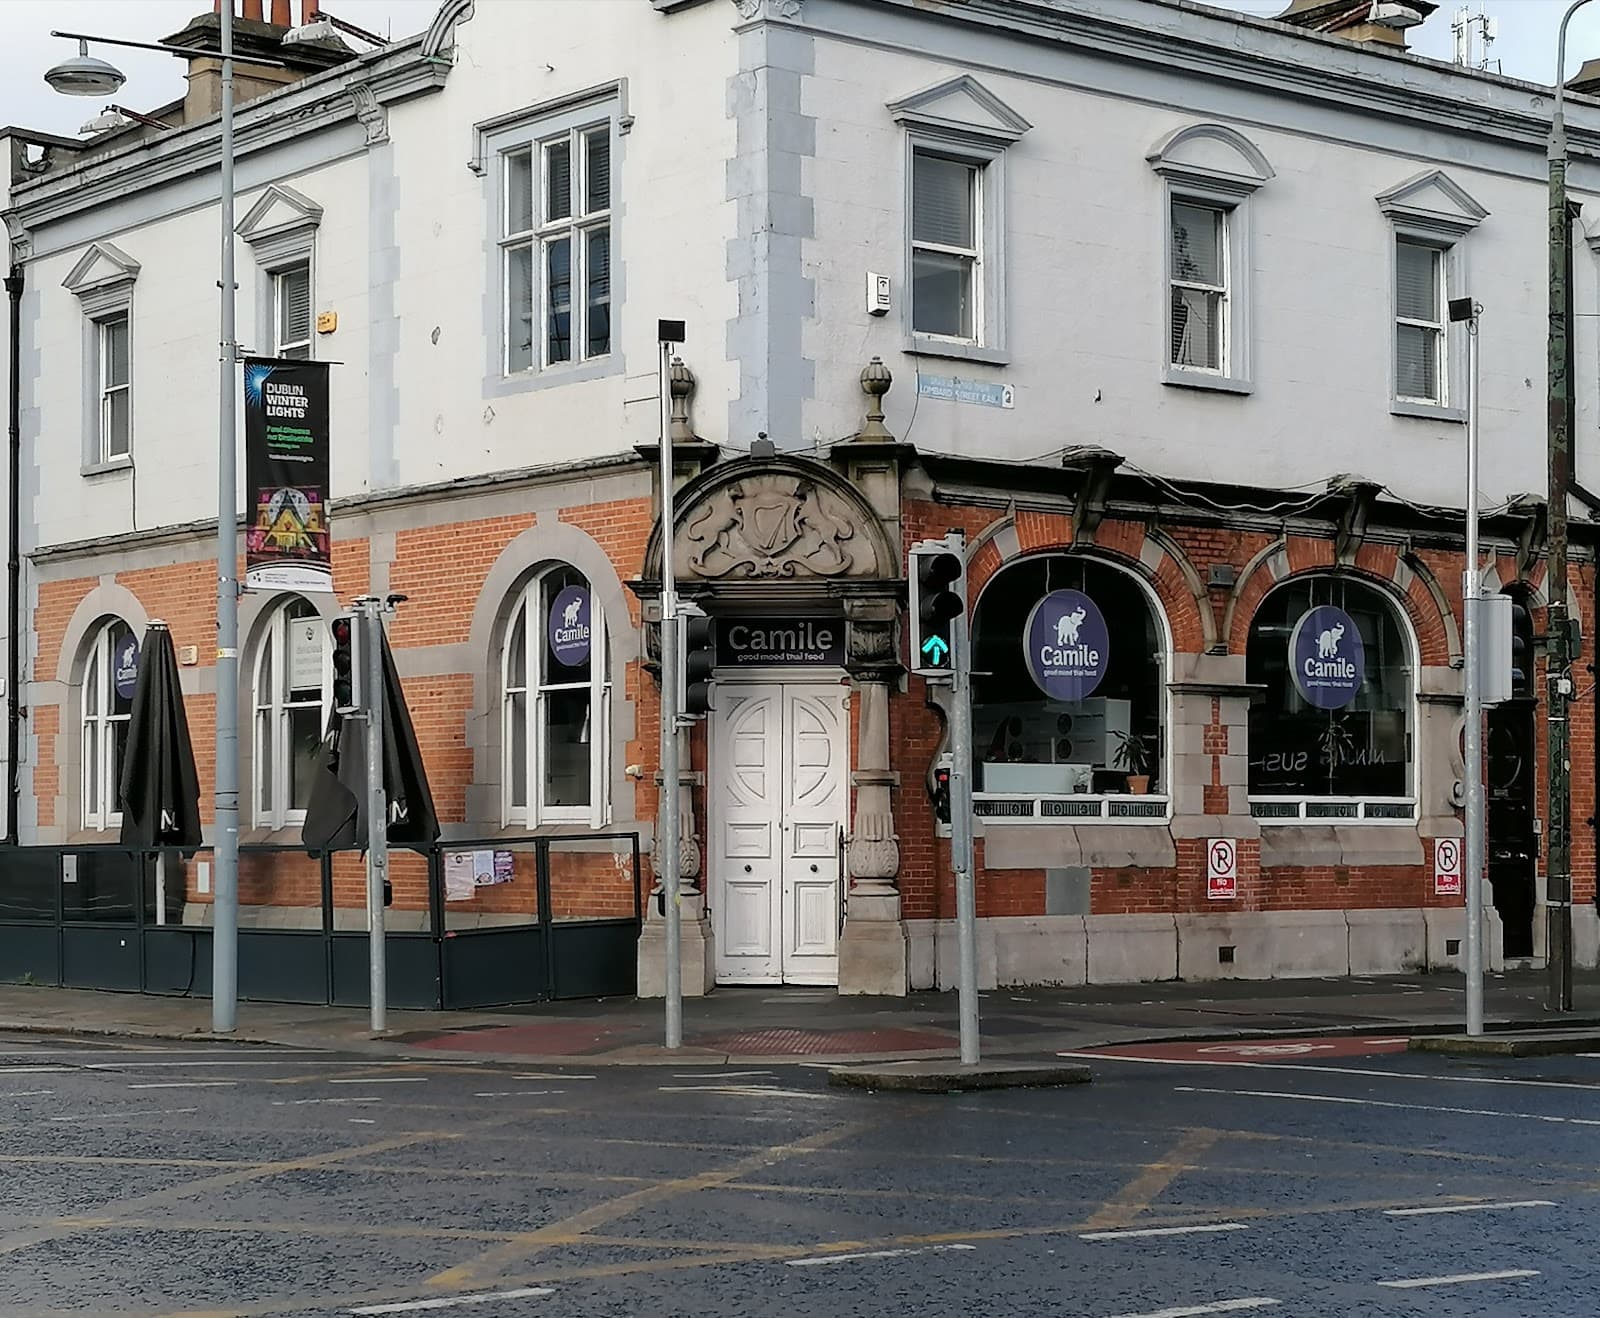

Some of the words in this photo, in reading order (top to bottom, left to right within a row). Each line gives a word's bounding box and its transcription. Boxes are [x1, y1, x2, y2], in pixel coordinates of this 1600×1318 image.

[266, 382, 304, 396] DUBLIN
[266, 394, 309, 408] WINTER
[1005, 390, 1012, 404] 2
[266, 405, 305, 418] LIGHTS
[554, 623, 590, 643] Camile
[729, 622, 833, 650] Camile
[737, 652, 760, 662] good
[760, 652, 785, 661] mood
[804, 651, 825, 661] food
[1041, 644, 1099, 667] Camile
[1304, 657, 1355, 679] Camile
